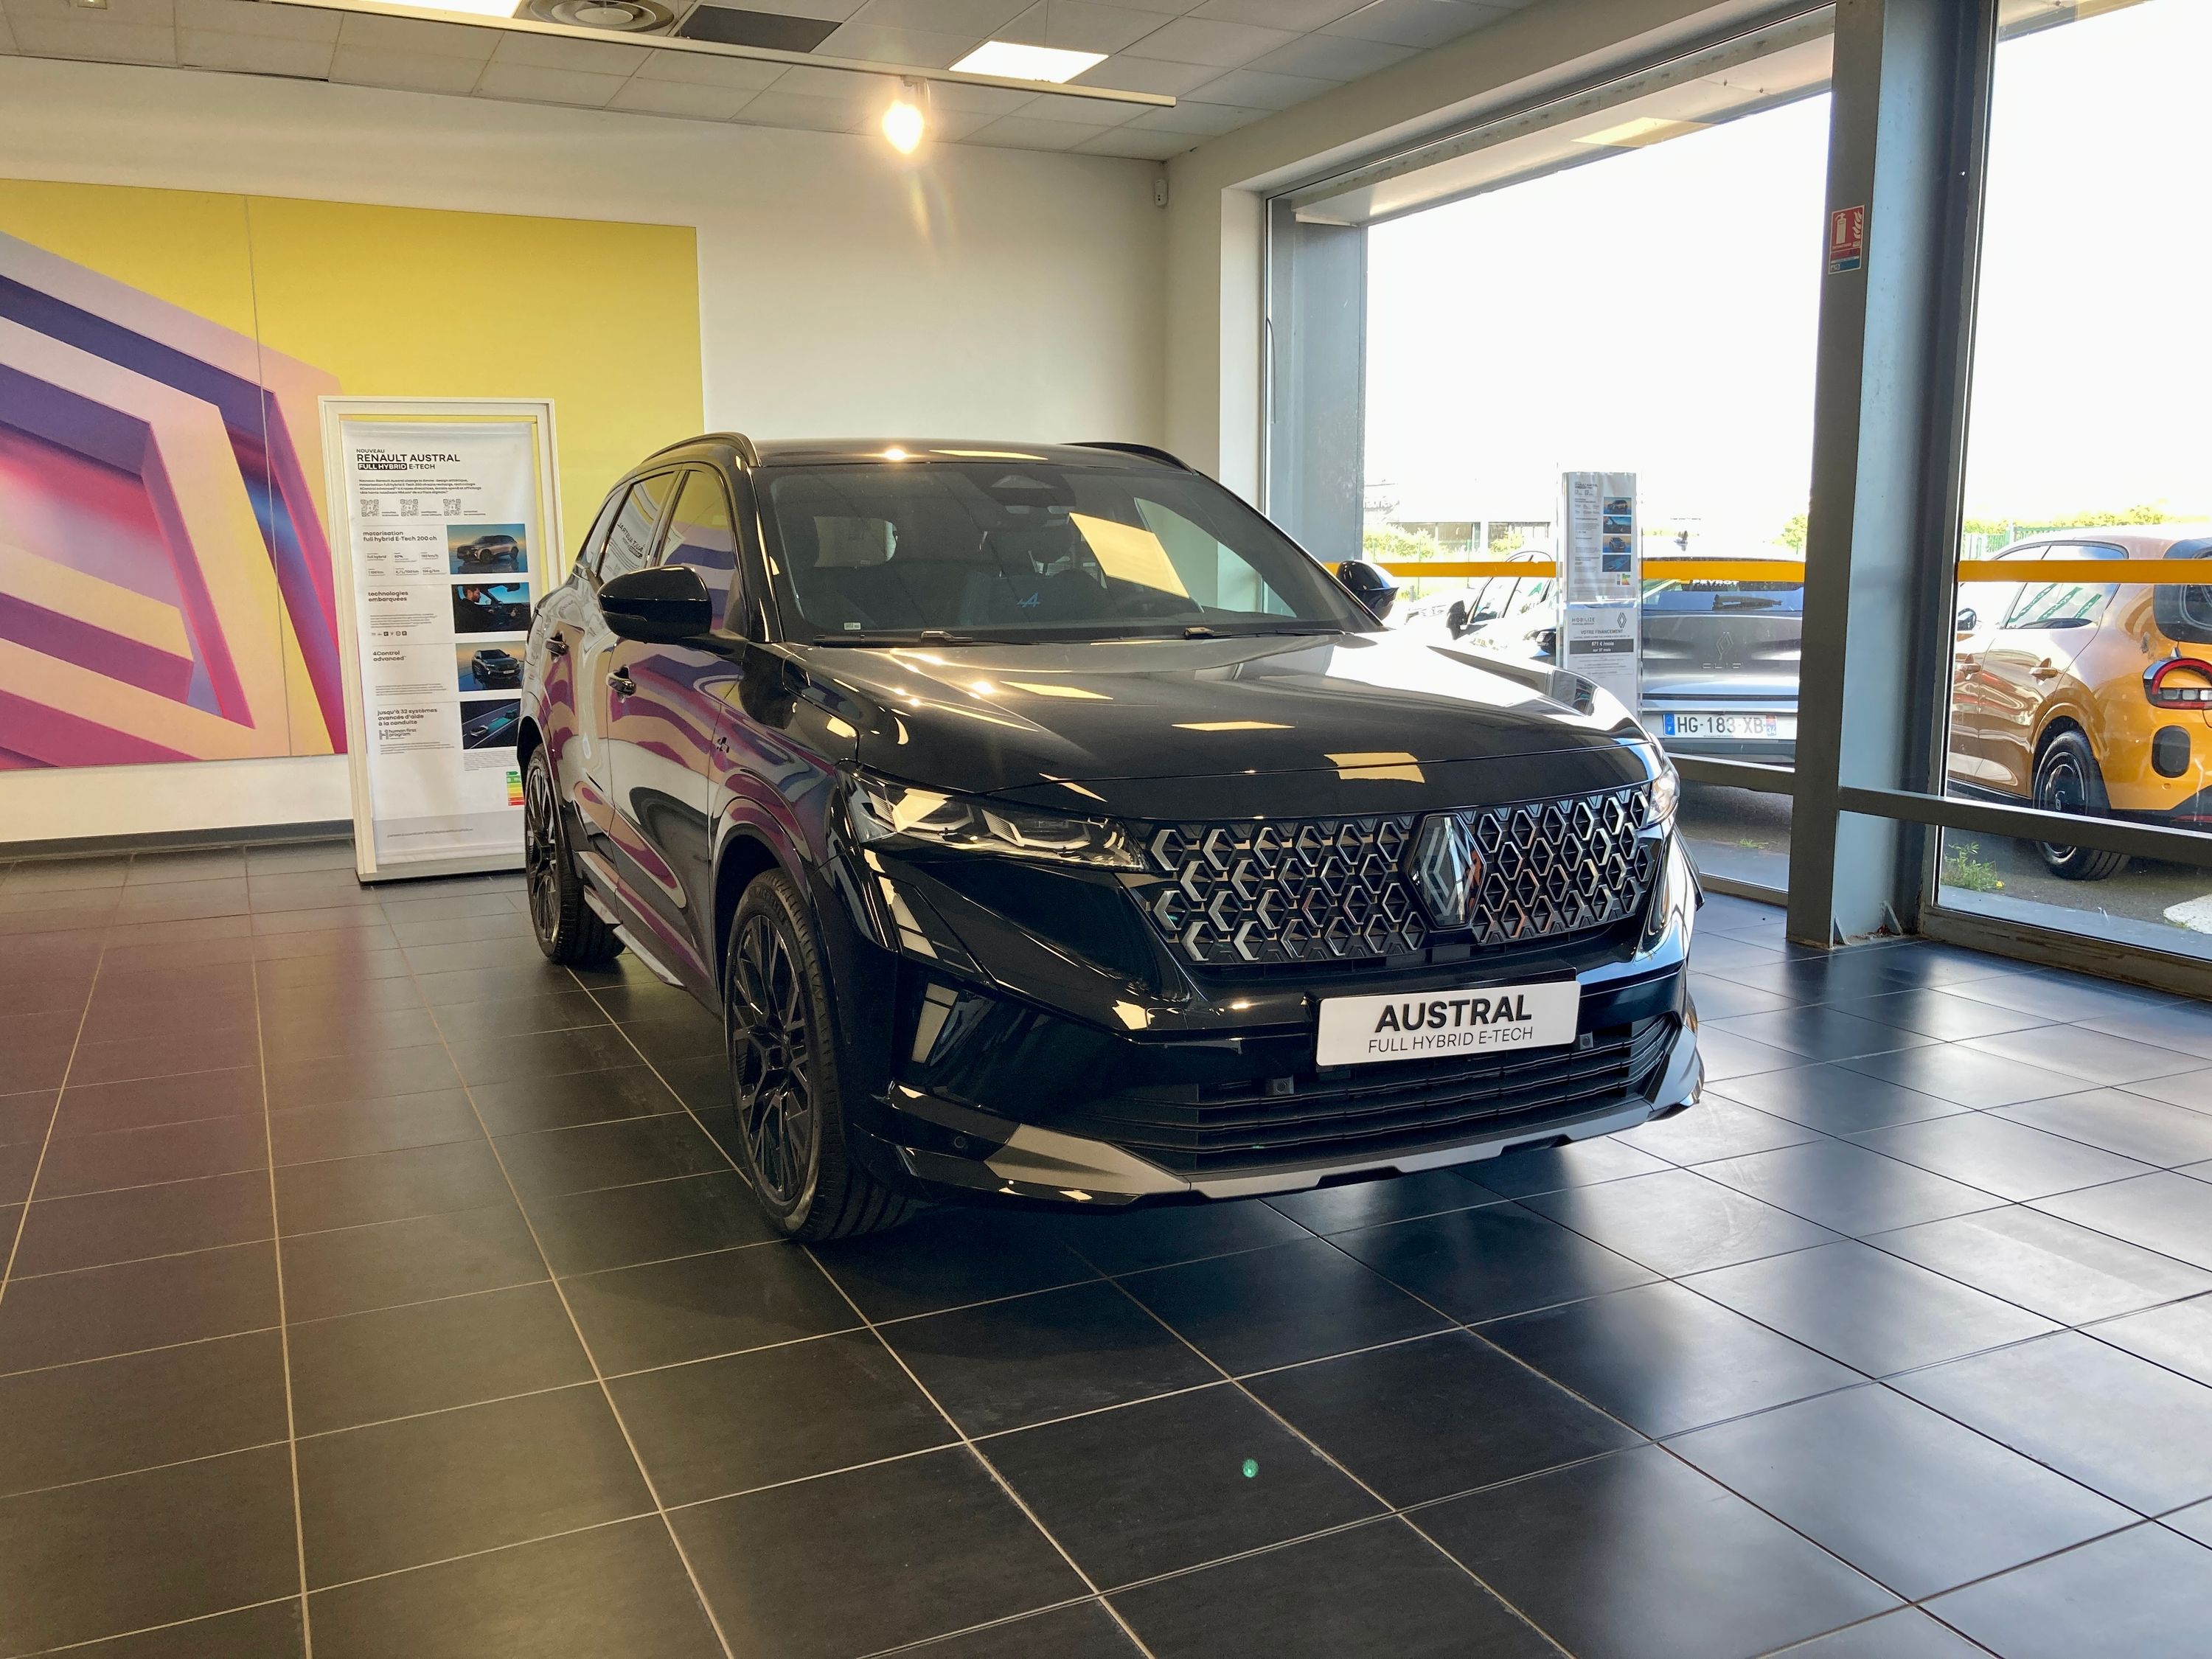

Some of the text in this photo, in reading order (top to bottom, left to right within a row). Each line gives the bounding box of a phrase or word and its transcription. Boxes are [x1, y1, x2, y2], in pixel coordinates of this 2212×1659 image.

[357, 453, 461, 462] RENAULT AUSTRAL
[1677, 716, 1764, 734] HG-183-XB
[1374, 994, 1533, 1033] AUSTRAL
[1368, 1026, 1534, 1054] FULL HYBRID E-TECH
